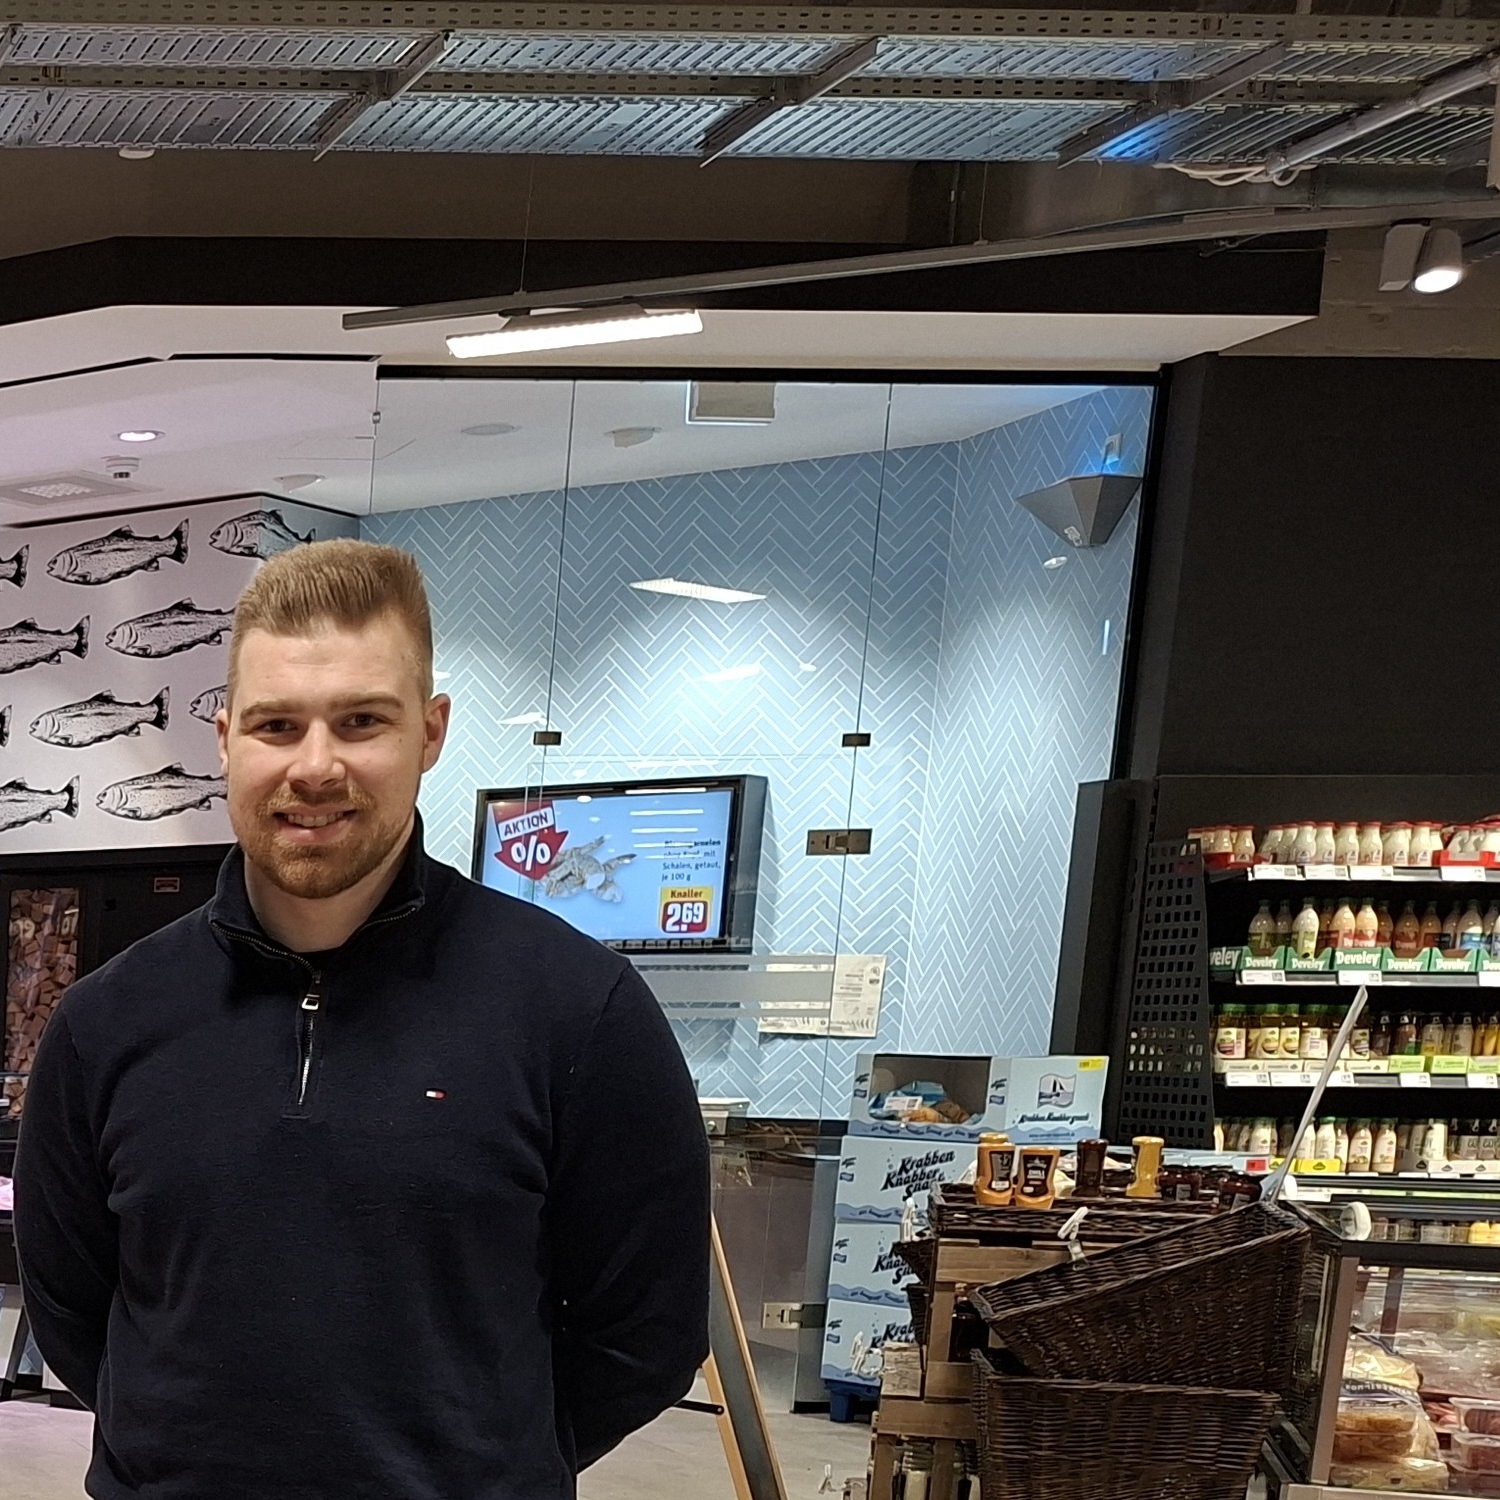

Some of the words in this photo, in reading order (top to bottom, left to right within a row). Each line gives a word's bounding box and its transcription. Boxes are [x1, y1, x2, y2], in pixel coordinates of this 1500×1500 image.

[504, 812, 548, 837] AKTION
[704, 850, 716, 858] mit
[663, 862, 692, 872] Schalen,
[671, 873, 684, 881] 100
[671, 889, 703, 898] Knaller
[1209, 949, 1239, 967] veley
[1245, 956, 1278, 968] Develey
[1292, 958, 1325, 970] Develey
[1336, 951, 1381, 967] Develey
[1388, 958, 1423, 971] Develey
[1436, 958, 1472, 971] Develey
[897, 1150, 955, 1176] Krabben
